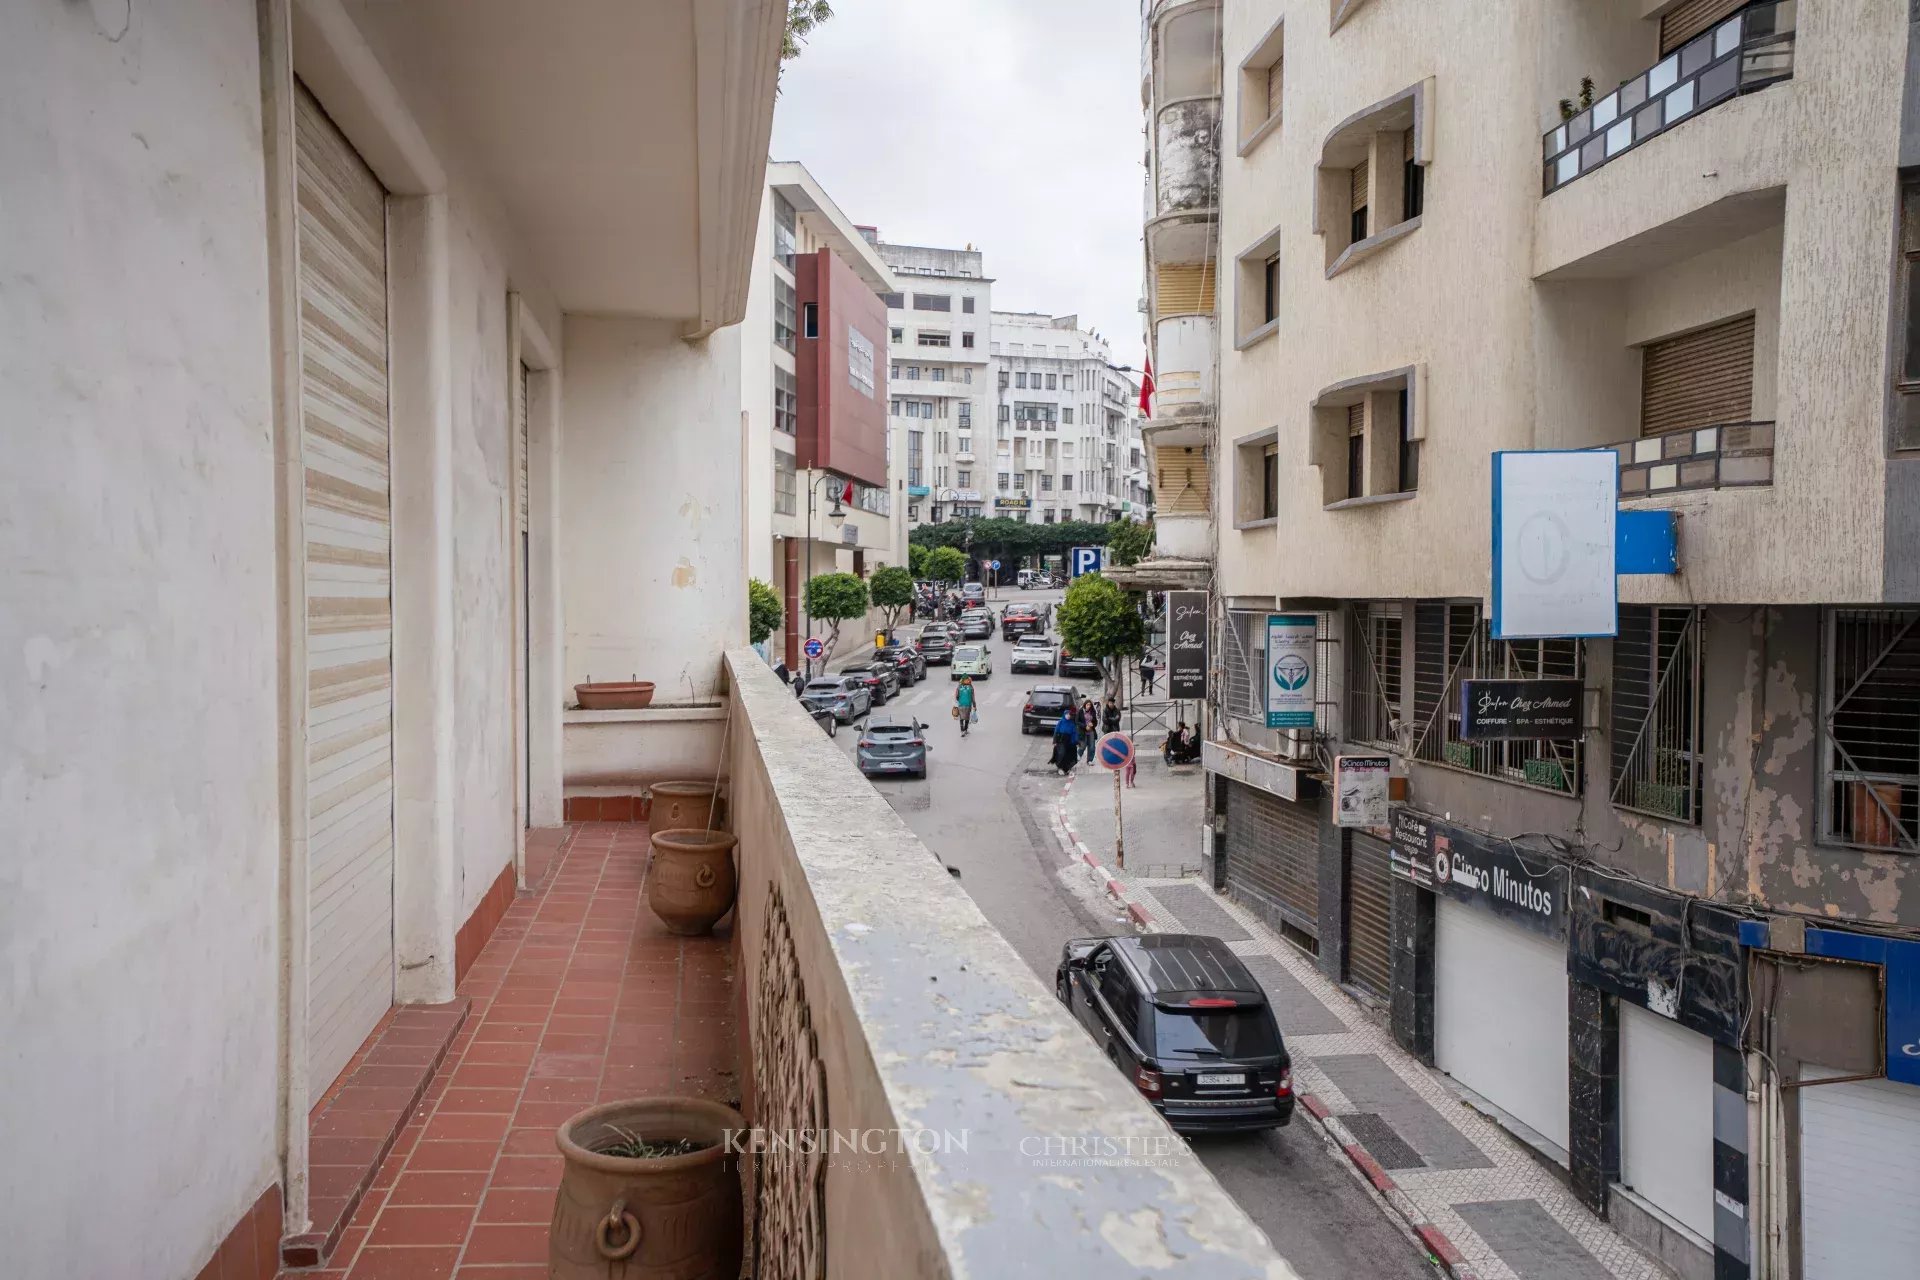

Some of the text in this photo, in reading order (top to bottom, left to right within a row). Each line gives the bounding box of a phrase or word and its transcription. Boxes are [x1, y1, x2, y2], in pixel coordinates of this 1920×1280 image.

[1078, 550, 1096, 574] P
[1180, 630, 1197, 642] Chez
[1173, 641, 1203, 650] Ahmed
[1478, 691, 1572, 715] Salon Chez Ahmed
[1534, 717, 1574, 725] ESTHÉTIQUE
[1347, 759, 1364, 767] Cinco
[1364, 759, 1388, 767] Minutos
[1404, 817, 1419, 832] Café
[1395, 827, 1428, 848] Restaurant
[1493, 866, 1552, 916] Minutos
